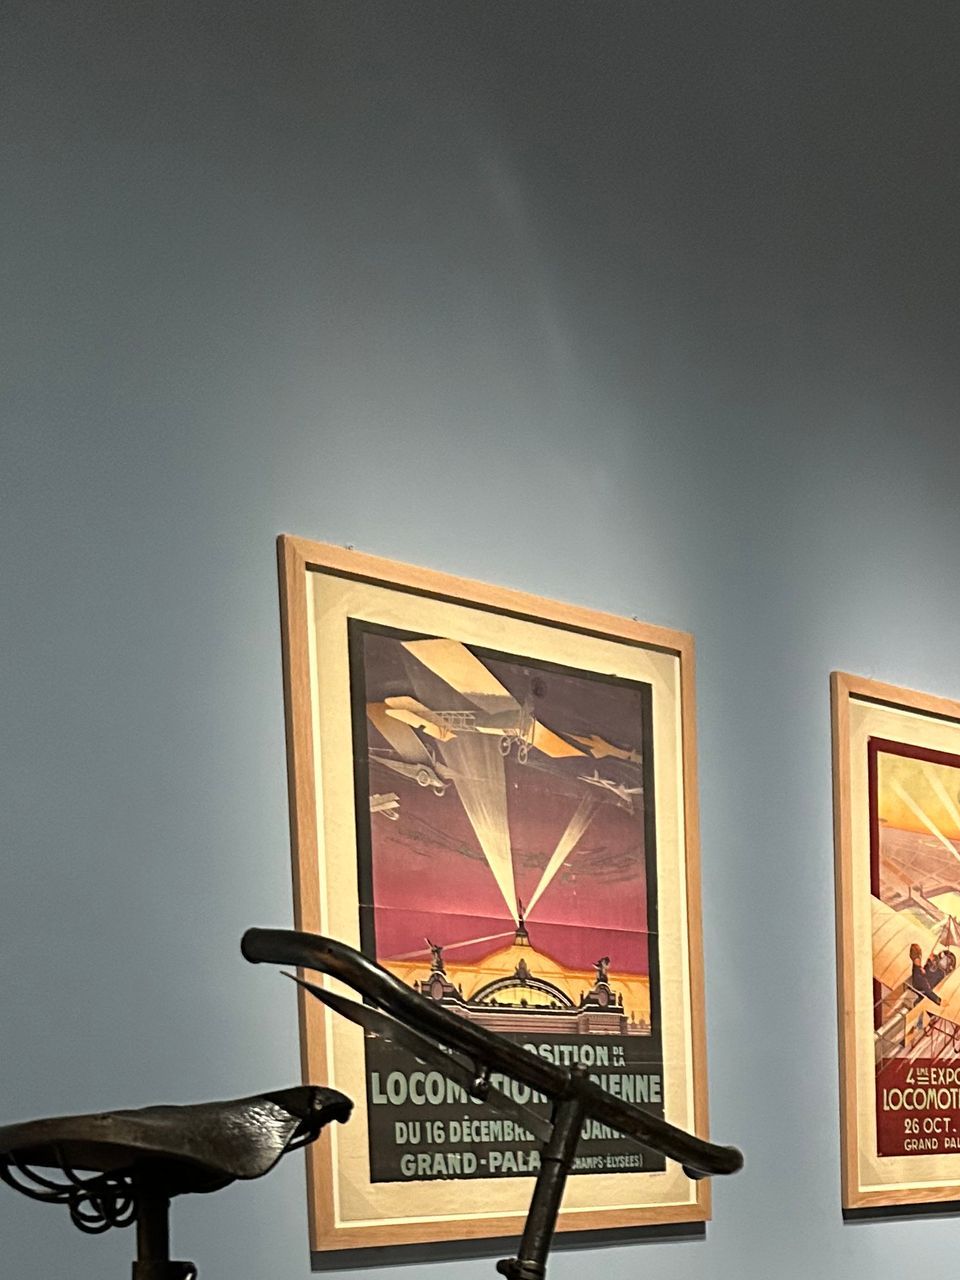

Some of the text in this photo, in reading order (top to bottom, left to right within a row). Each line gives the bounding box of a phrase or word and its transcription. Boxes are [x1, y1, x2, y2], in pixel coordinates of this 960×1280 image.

[612, 1046, 624, 1056] DE
[613, 1057, 626, 1067] LA
[371, 1071, 548, 1105] LOCOMTIO
[395, 1120, 421, 1144] DU
[426, 1120, 446, 1144] 16
[904, 1117, 919, 1134] 26
[923, 1117, 957, 1134] OCT.
[904, 1137, 938, 1151] GRAND
